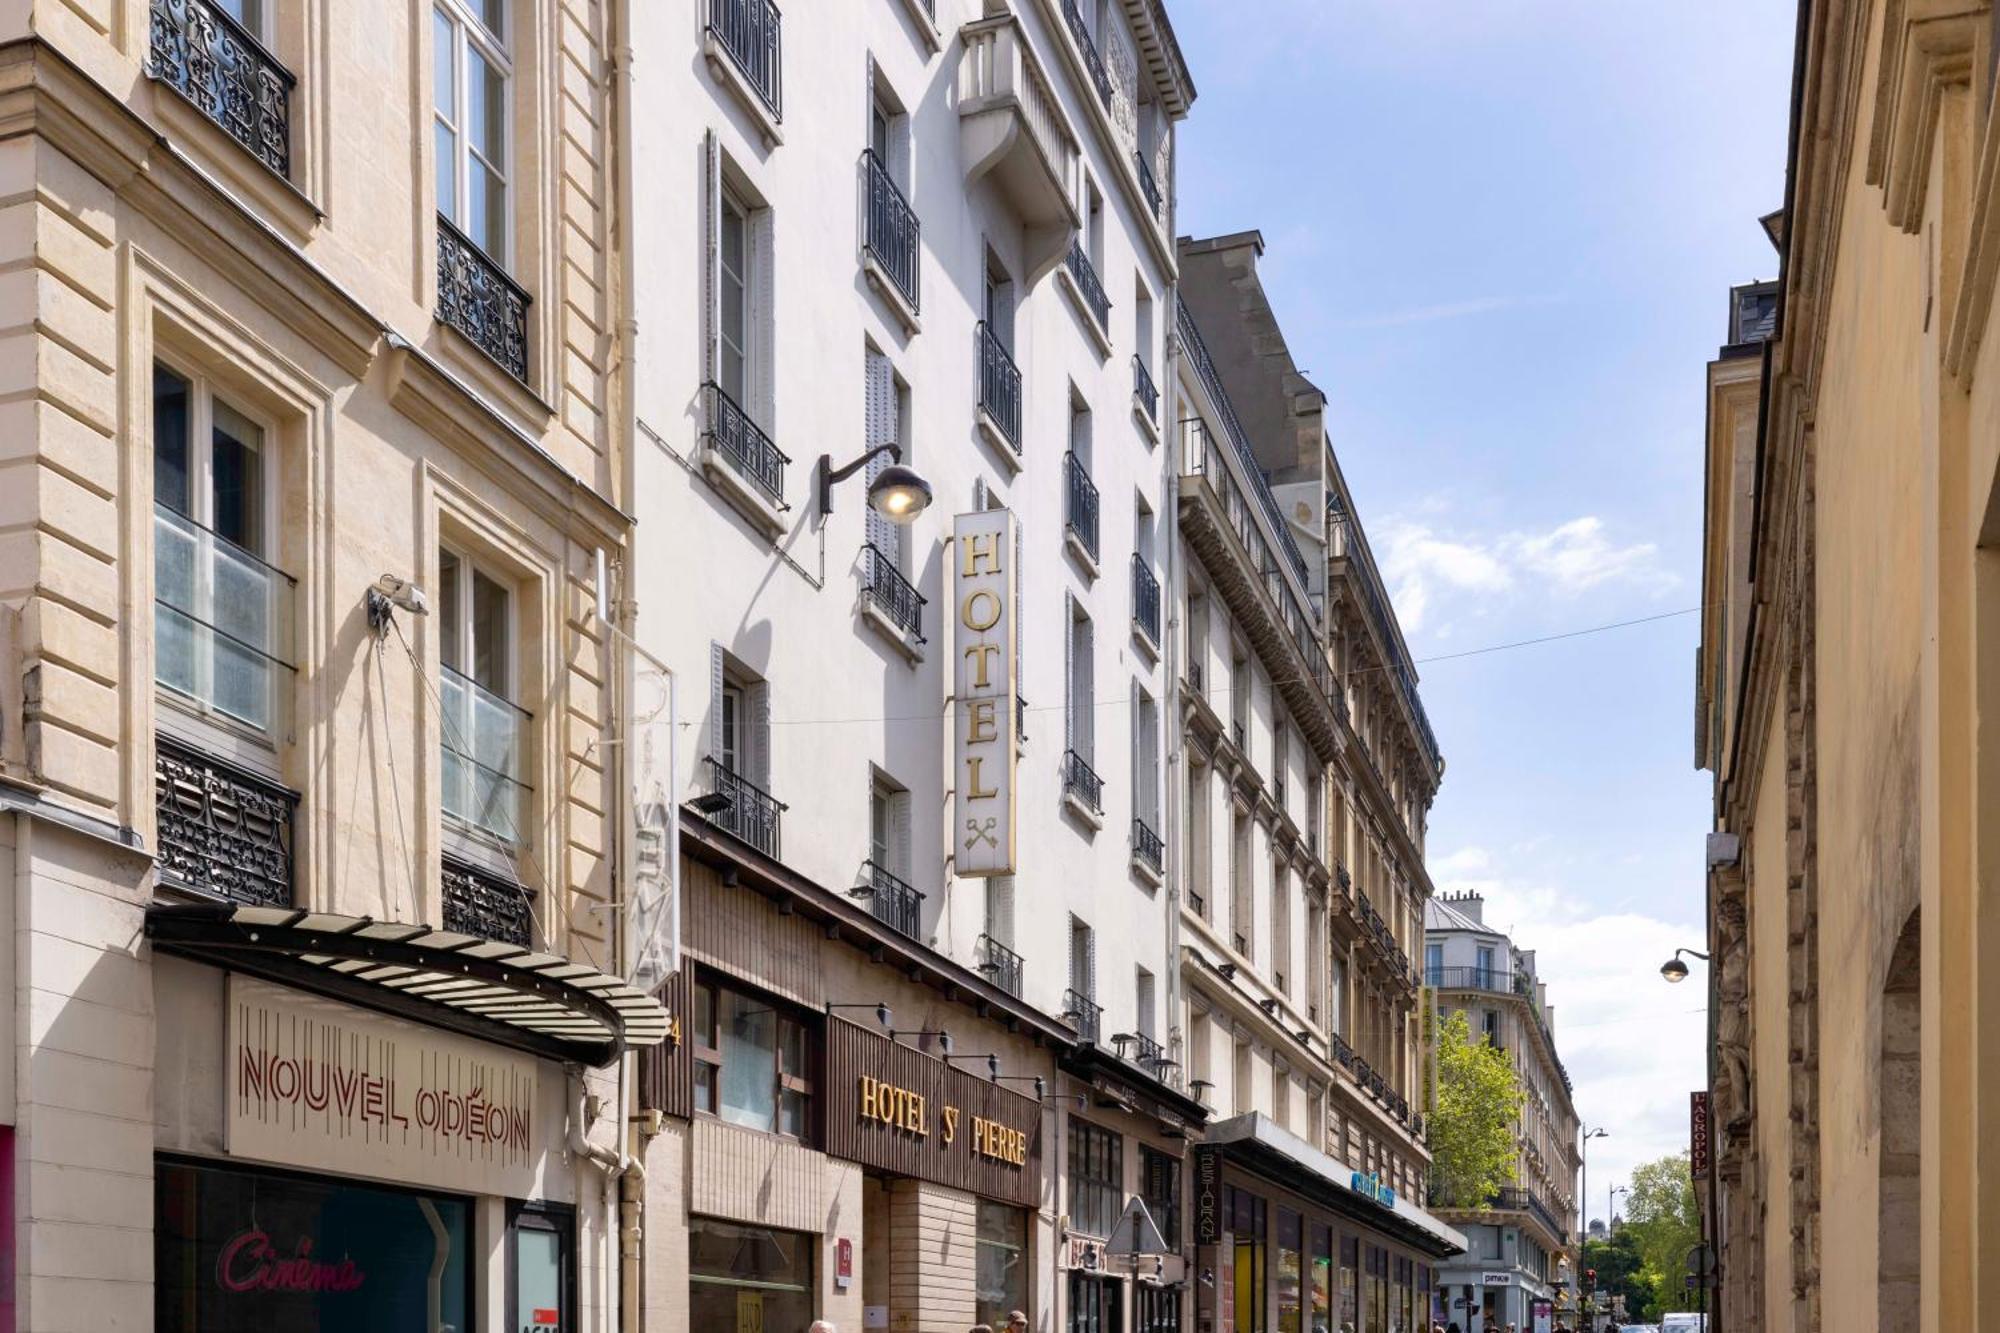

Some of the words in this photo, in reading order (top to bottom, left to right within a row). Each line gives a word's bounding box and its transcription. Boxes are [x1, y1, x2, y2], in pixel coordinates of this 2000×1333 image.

[962, 530, 1002, 802] HOTEL
[239, 1044, 409, 1131] NOUVEL
[415, 1086, 531, 1154] ODÉON
[860, 1074, 930, 1136] HOTEL
[970, 1114, 1027, 1166] PIERRE
[216, 1229, 366, 1292] Cinéma
